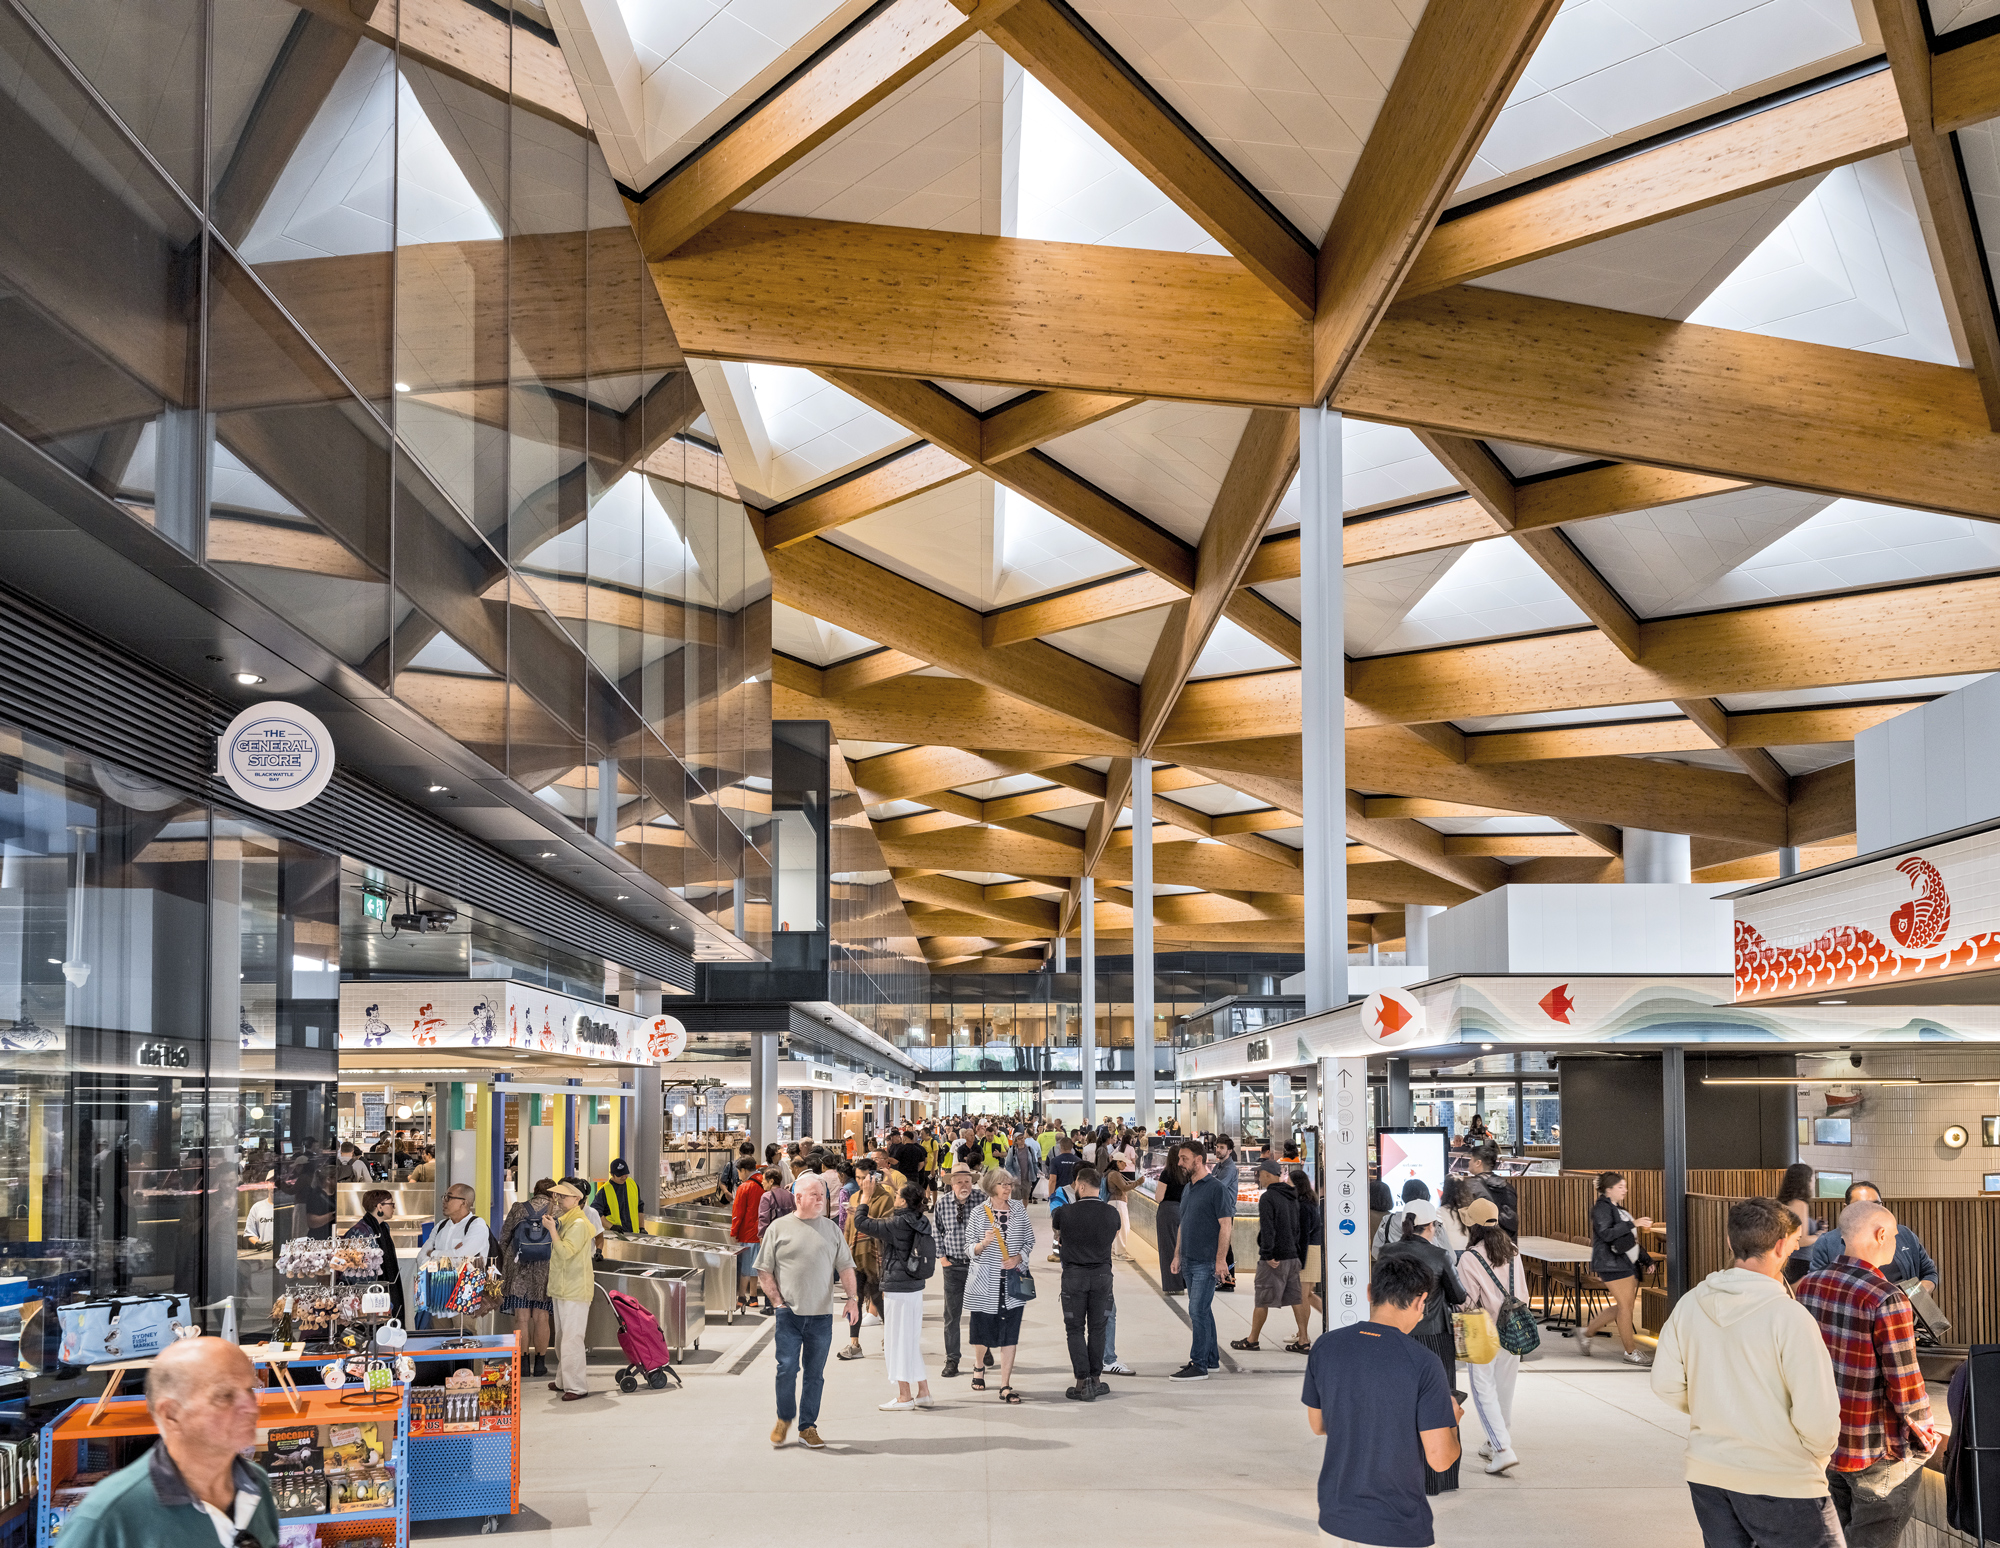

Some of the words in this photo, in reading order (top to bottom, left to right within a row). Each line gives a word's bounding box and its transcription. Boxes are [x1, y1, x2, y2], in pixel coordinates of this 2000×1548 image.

[263, 729, 286, 738] THE
[236, 739, 313, 753] GENERAL
[247, 753, 302, 768] STORE
[131, 1331, 158, 1340] SYDNEY
[133, 1340, 159, 1349] MARKET
[269, 1429, 315, 1442] CROCODILE
